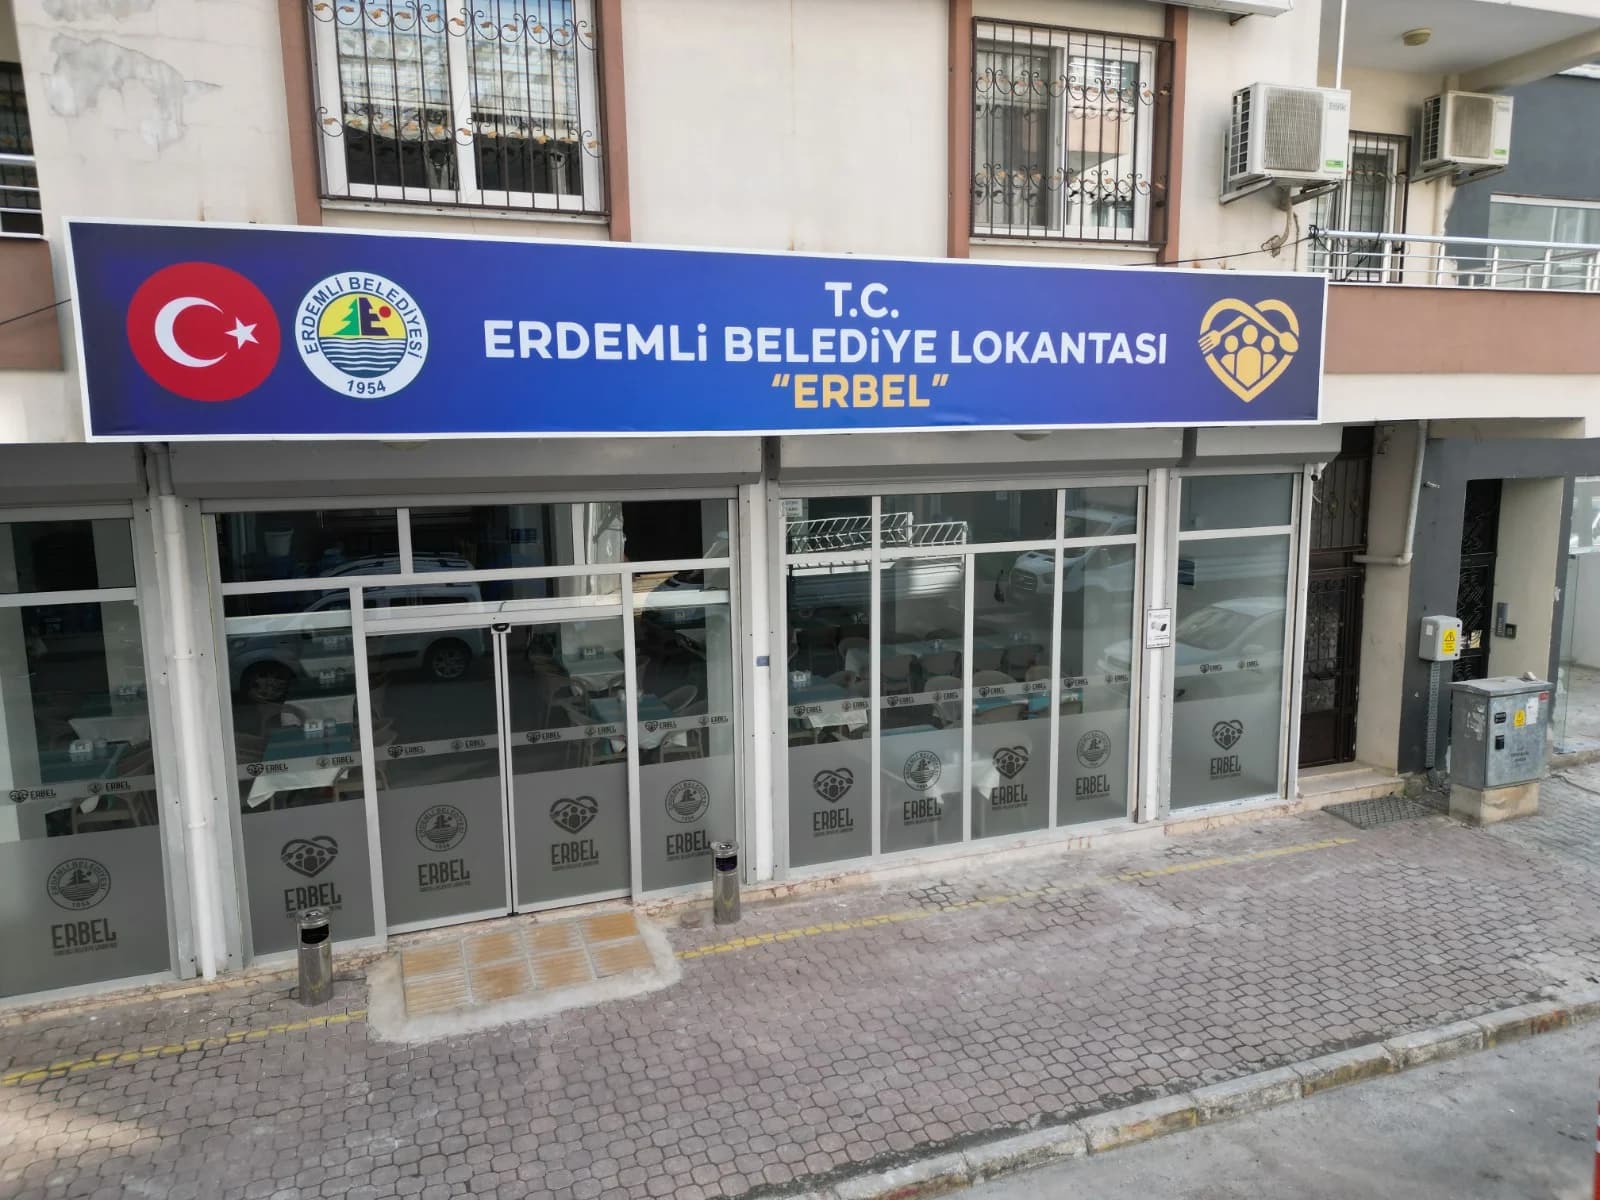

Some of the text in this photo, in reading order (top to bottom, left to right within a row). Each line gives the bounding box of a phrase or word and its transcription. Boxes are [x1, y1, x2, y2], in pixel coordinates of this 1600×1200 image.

[825, 282, 900, 318] T.C.
[951, 329, 1168, 365] LOKANTASI
[347, 380, 386, 395] 1954
[1210, 755, 1241, 775] ERBEL
[992, 784, 1027, 805] ERBEL
[1076, 774, 1110, 795] ERBEL
[813, 808, 853, 831] ERBEL
[904, 797, 941, 820] ERBEL
[551, 839, 599, 865] ERBEL
[666, 830, 711, 855] ERBEL
[417, 858, 470, 886] ERBEL
[284, 882, 342, 912] ERBEL
[51, 918, 117, 949] ERBEL
